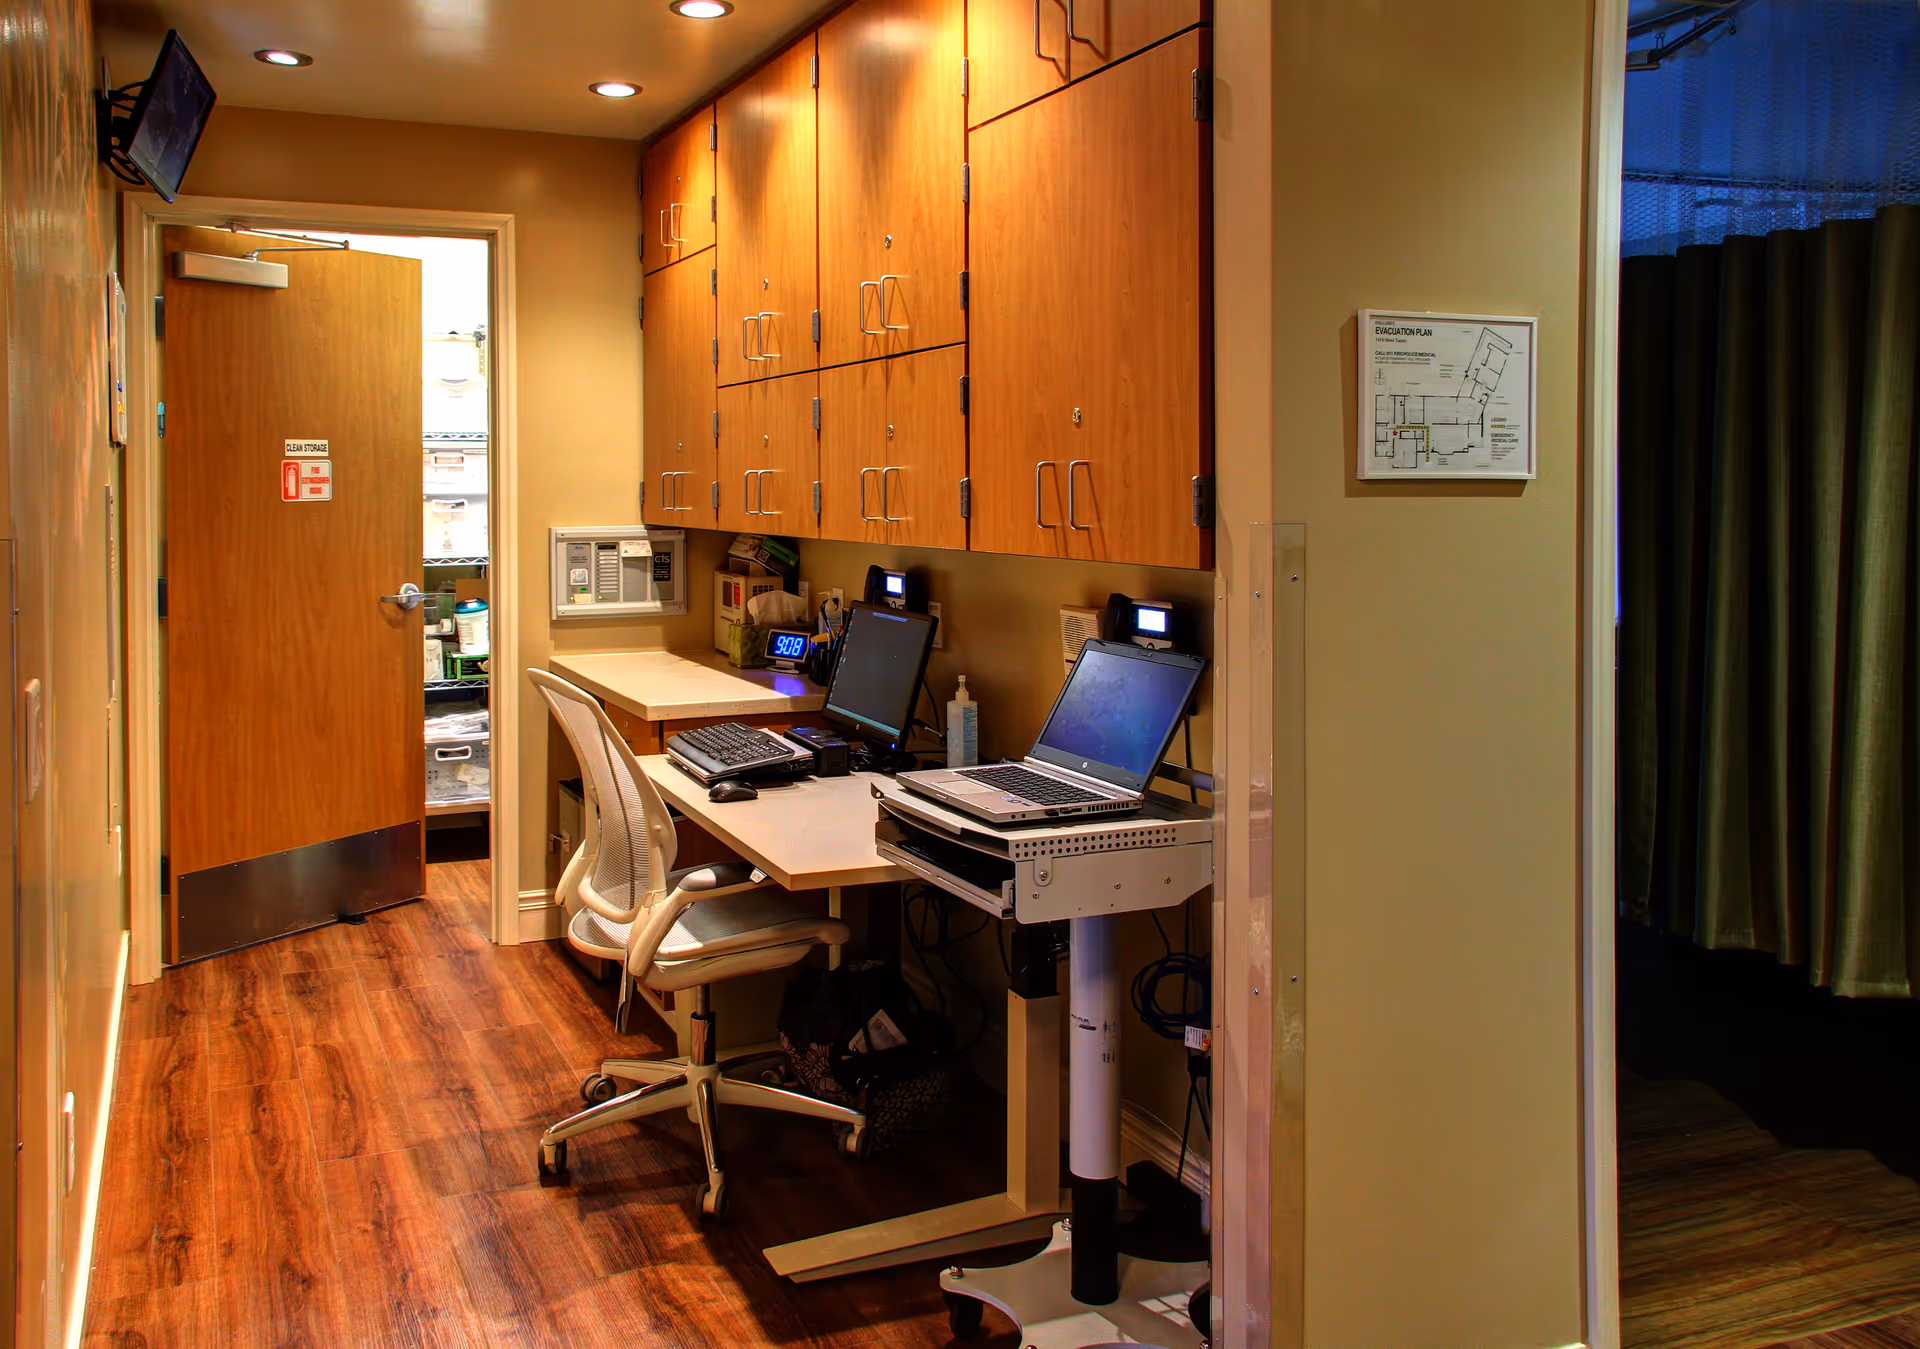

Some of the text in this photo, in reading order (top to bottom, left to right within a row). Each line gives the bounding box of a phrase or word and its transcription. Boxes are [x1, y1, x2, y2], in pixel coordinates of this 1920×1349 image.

[1375, 327, 1432, 336] EVACUATION PLAN
[286, 443, 327, 452] CLEAN STORAGE
[775, 636, 804, 656] 9:08
